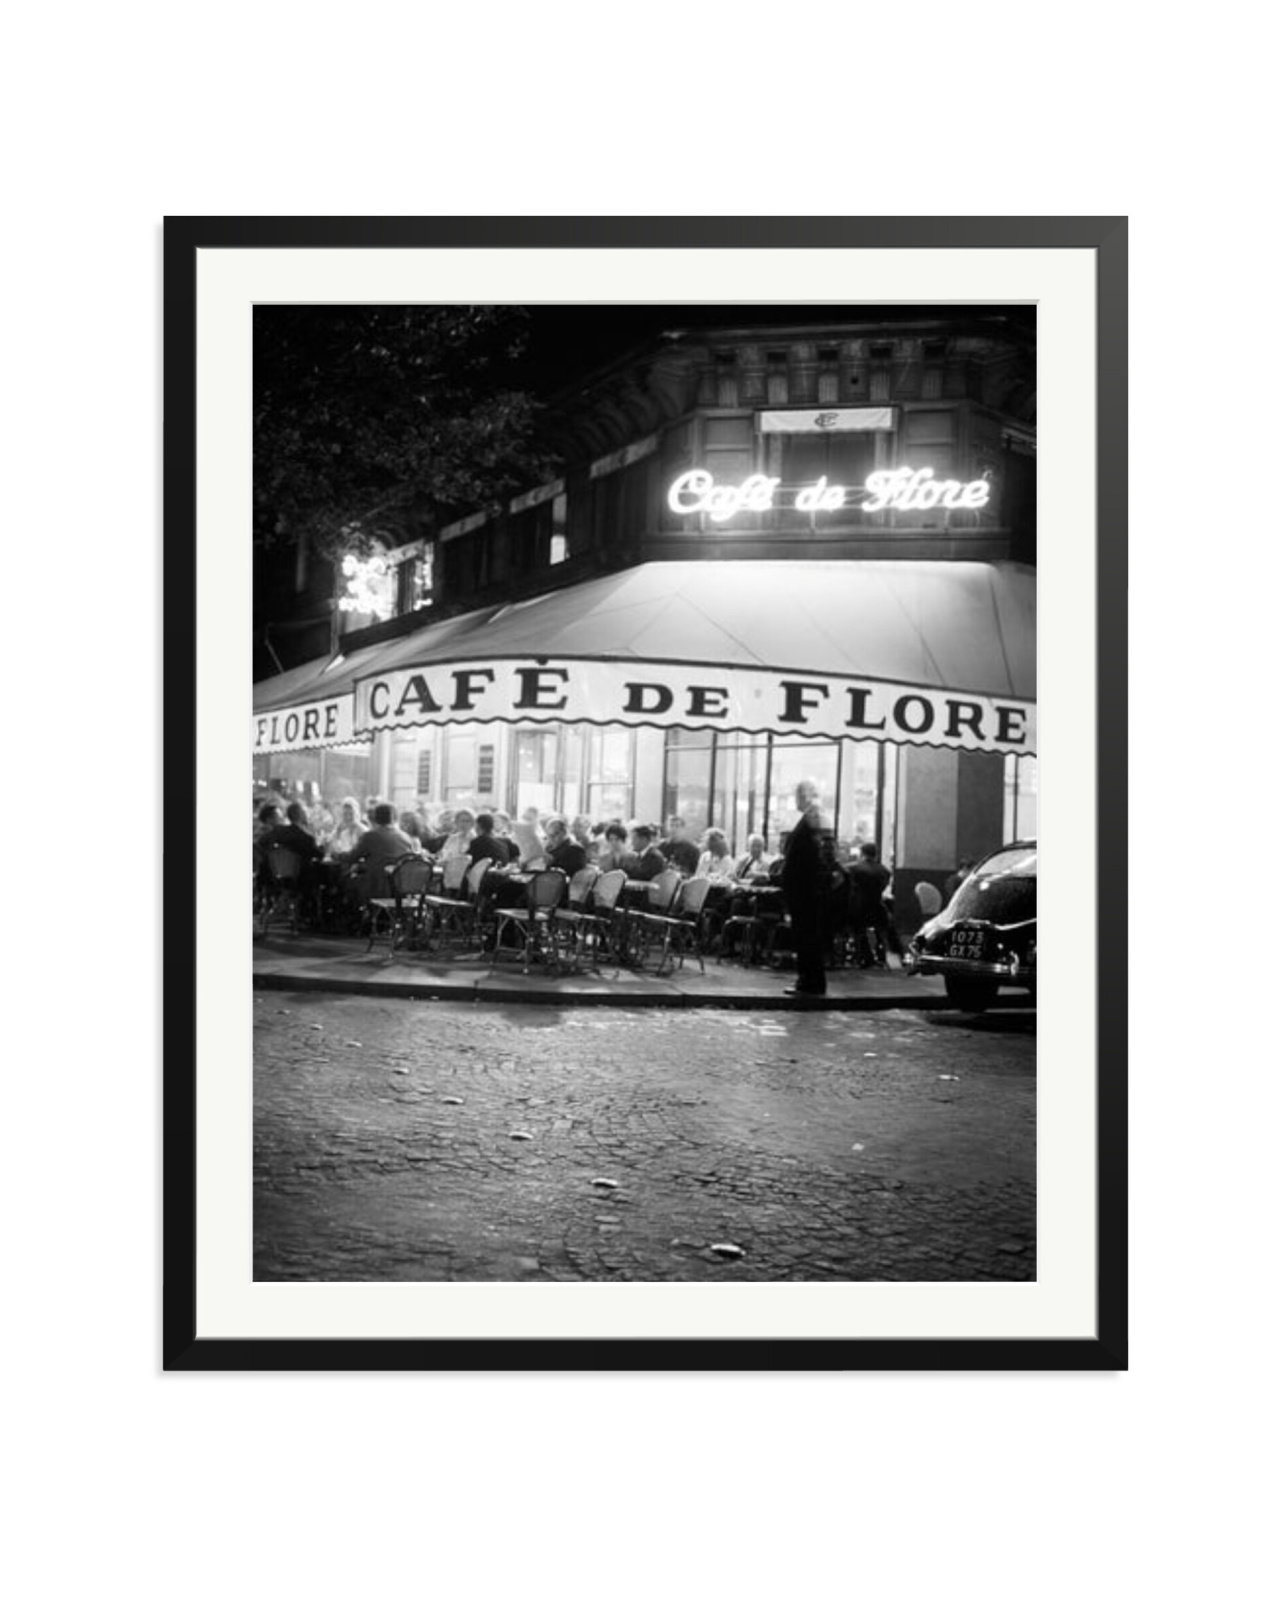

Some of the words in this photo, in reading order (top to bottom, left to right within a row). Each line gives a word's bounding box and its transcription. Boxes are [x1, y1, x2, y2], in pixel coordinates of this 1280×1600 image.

[794, 475, 846, 512] de
[862, 467, 989, 512] Flore
[255, 704, 338, 746] FLORE
[622, 682, 730, 719] DE
[777, 680, 1027, 745] FLORE
[952, 931, 984, 944] 1073
